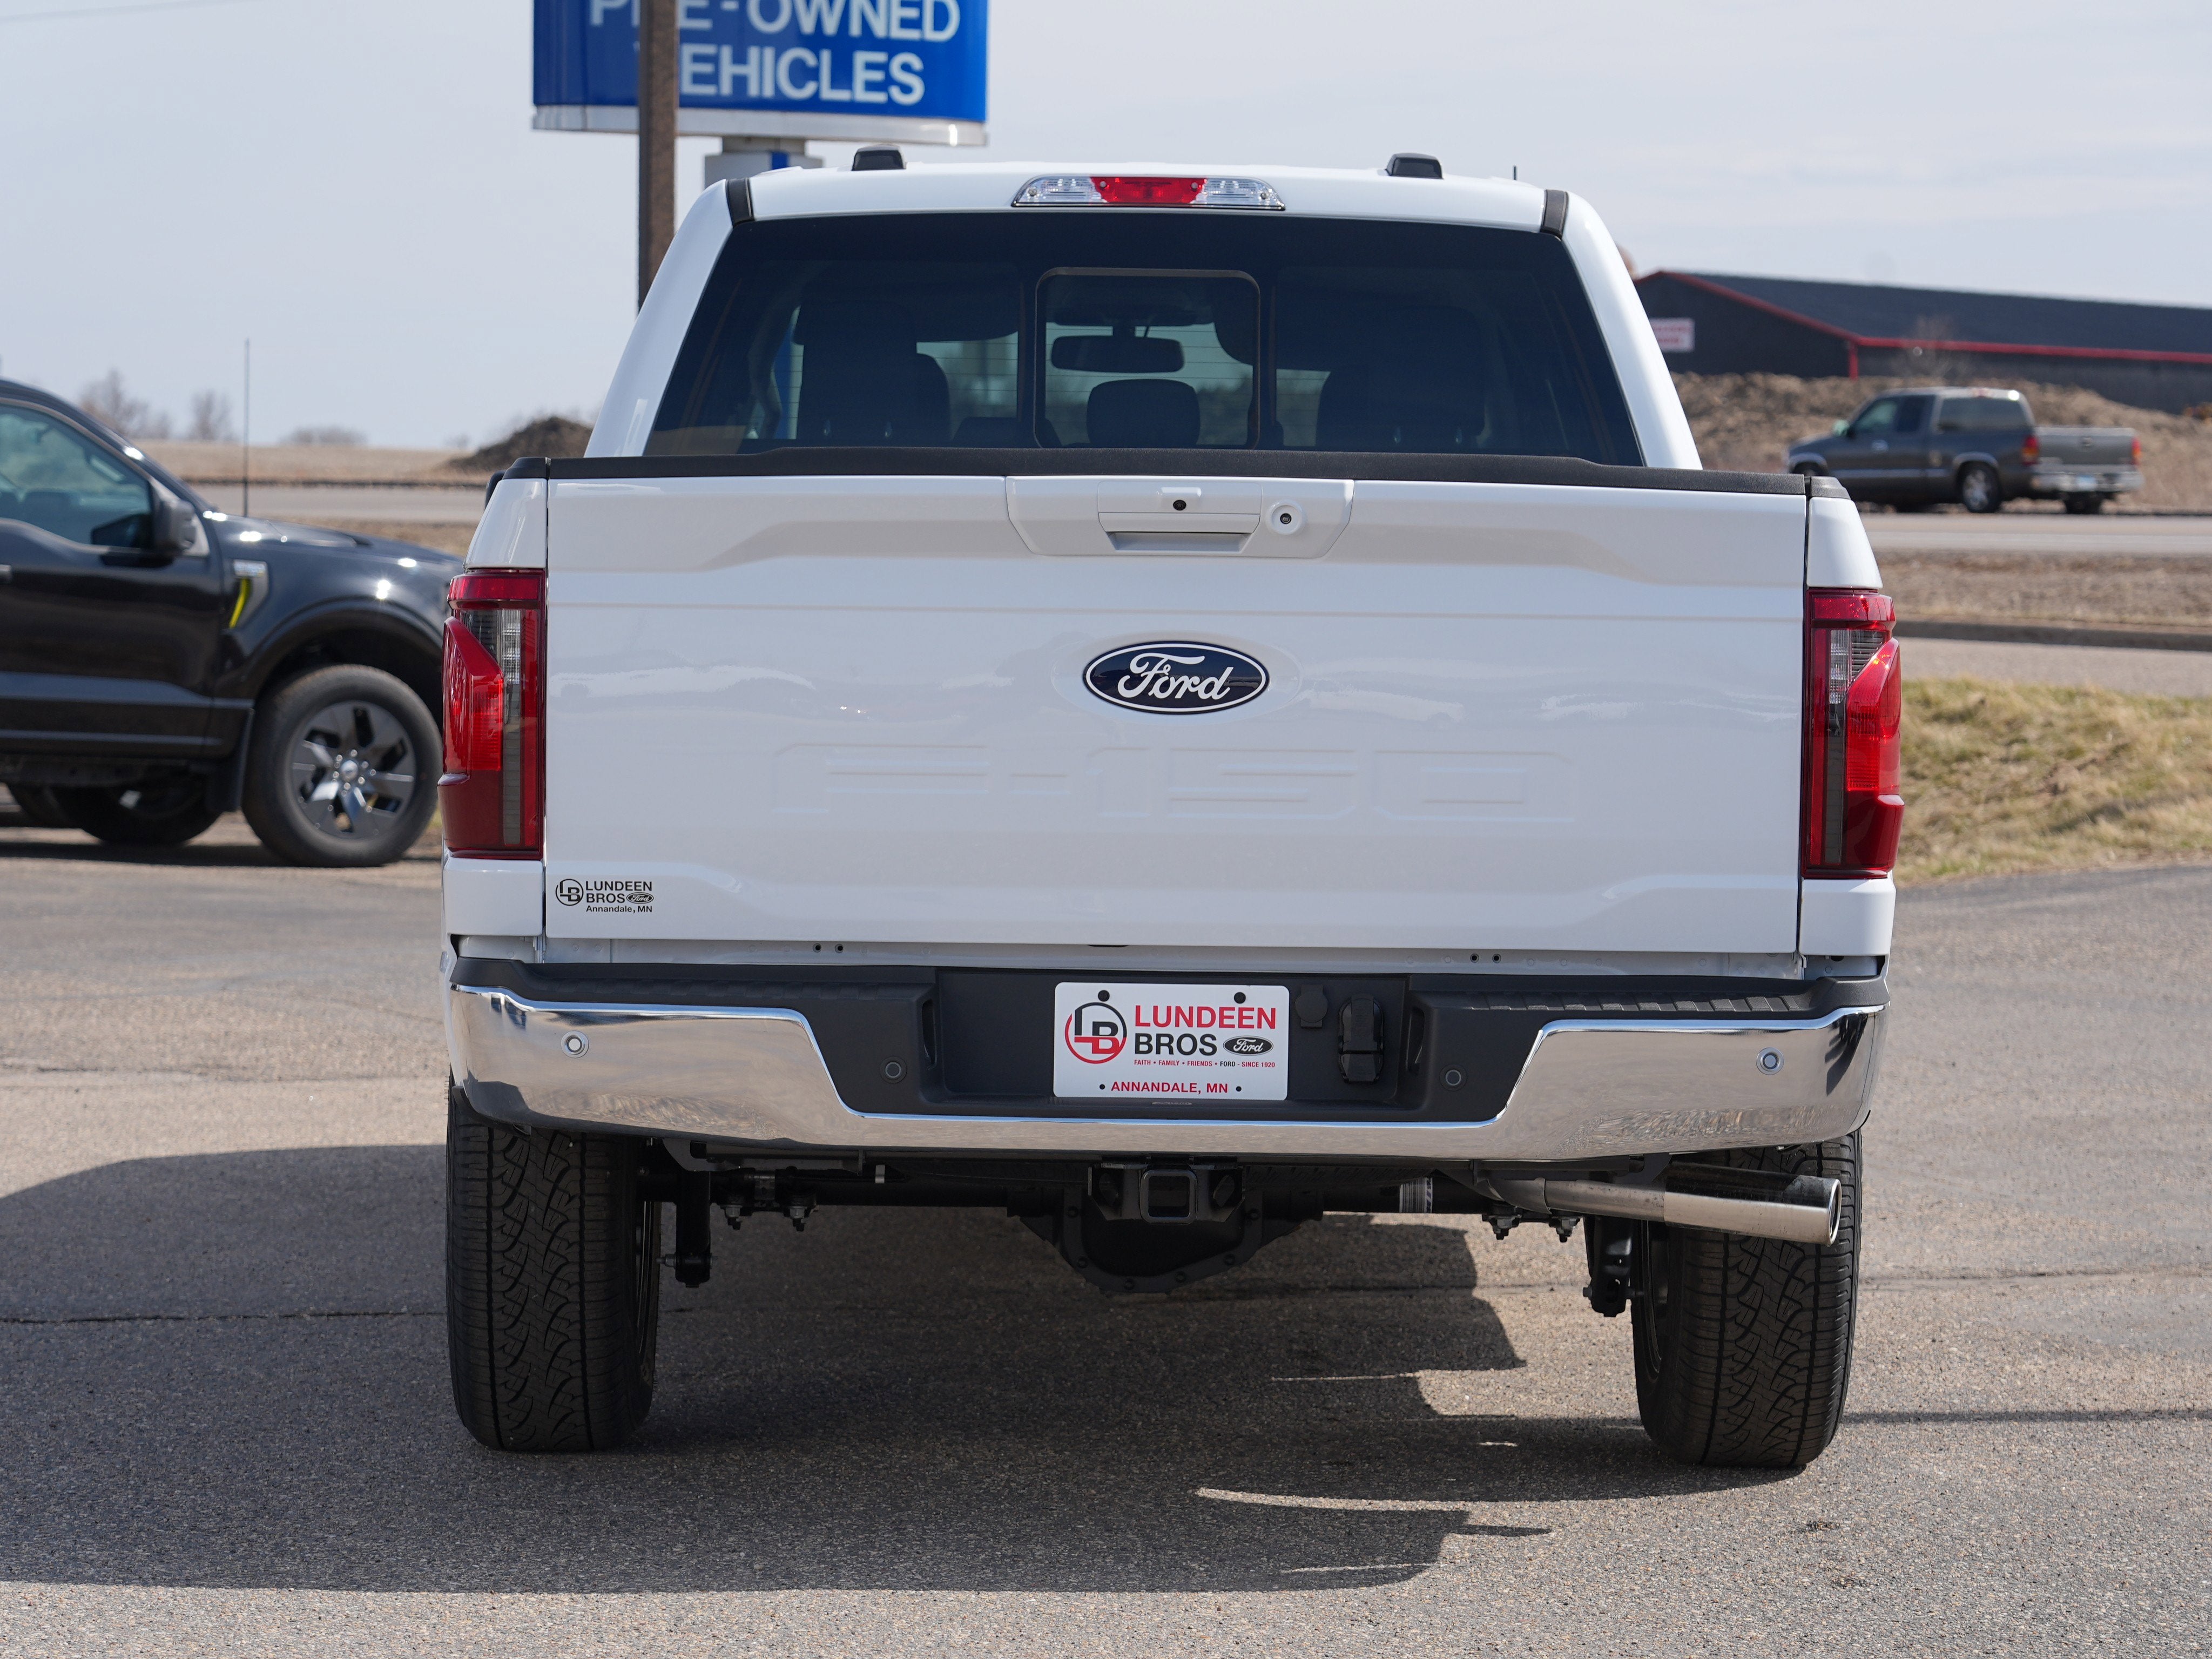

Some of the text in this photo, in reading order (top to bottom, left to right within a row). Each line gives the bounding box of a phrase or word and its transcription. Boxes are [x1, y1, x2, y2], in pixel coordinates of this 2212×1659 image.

[633, 41, 925, 105] EHICLES
[1117, 652, 1234, 700] Ford
[585, 881, 652, 891] LUNDEEN
[586, 893, 625, 903] BROS
[586, 905, 636, 914] Annandale,
[1135, 1005, 1276, 1029] LUNDEEN
[1135, 1033, 1217, 1056] BROS
[1232, 1037, 1264, 1053] Ford
[1111, 1081, 1229, 1095] ANNANDALE, MN
